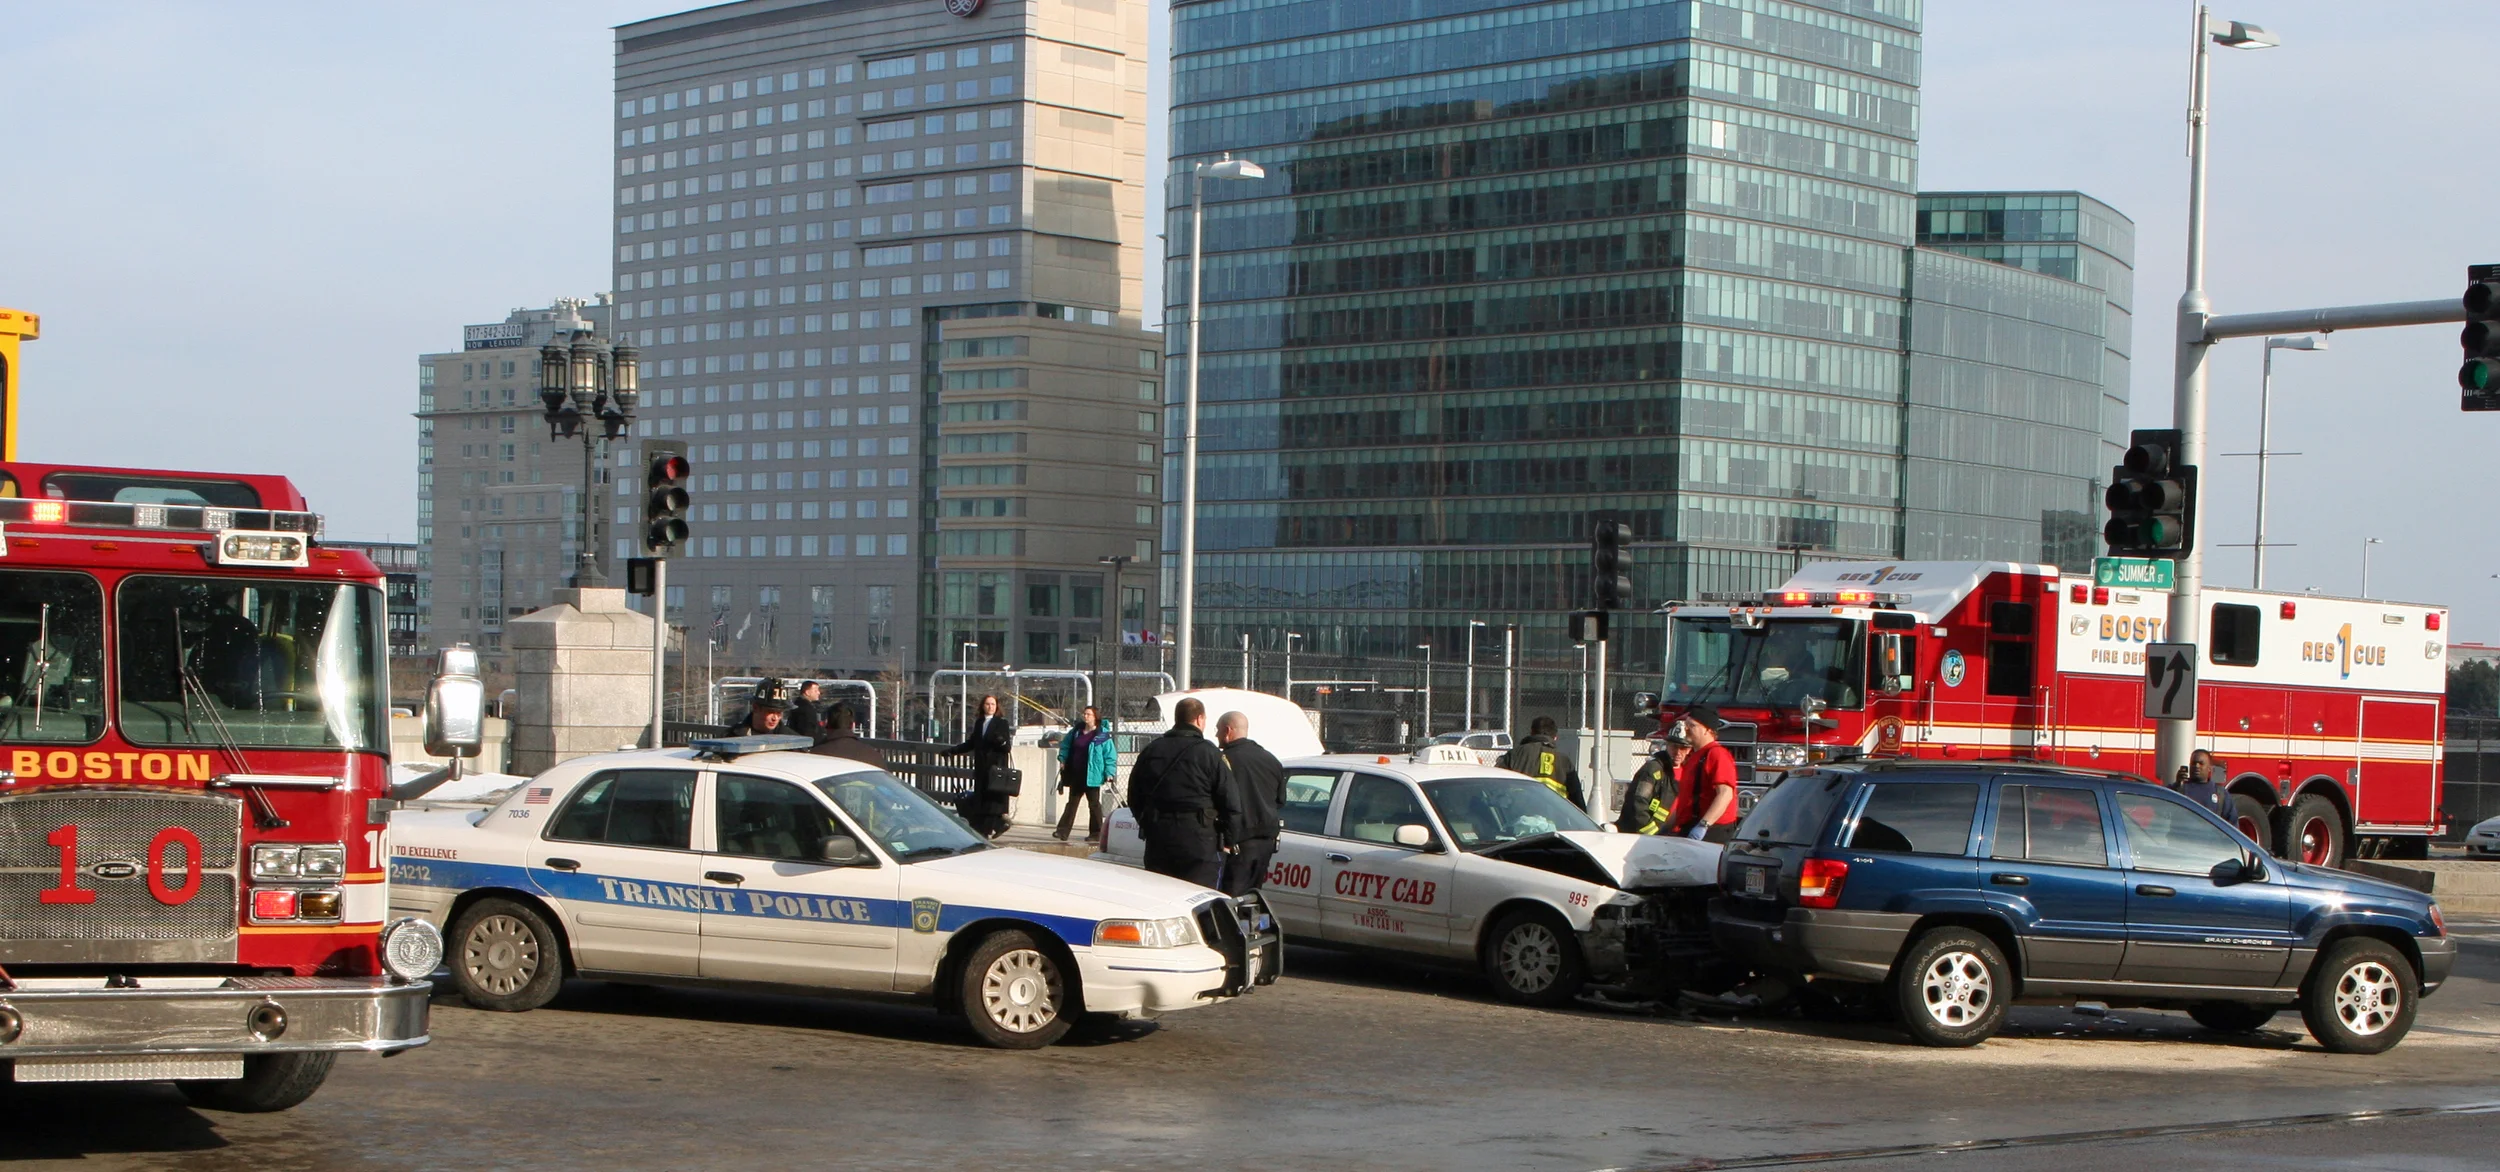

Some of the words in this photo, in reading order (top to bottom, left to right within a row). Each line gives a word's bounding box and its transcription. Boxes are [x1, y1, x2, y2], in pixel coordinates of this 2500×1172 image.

[467, 325, 521, 339] 617-542-3200
[466, 341, 483, 349] NOW
[489, 339, 520, 348] LEASING
[2118, 564, 2155, 583] SUMMER
[2099, 614, 2168, 643] BOST
[2092, 649, 2118, 664] FIRE
[2123, 651, 2146, 665] DEP
[1440, 750, 1467, 761] TAXI
[12, 750, 210, 781] BOSTON
[508, 809, 530, 818] 7036
[396, 845, 406, 855] TO
[409, 846, 457, 859] EXCELLENCE
[1335, 870, 1390, 900] CITY
[1392, 877, 1436, 906] CAB
[597, 877, 735, 912] TRANSIT
[746, 892, 870, 921] POLICE
[1568, 891, 1588, 907] 995
[1376, 917, 1390, 931] CAB
